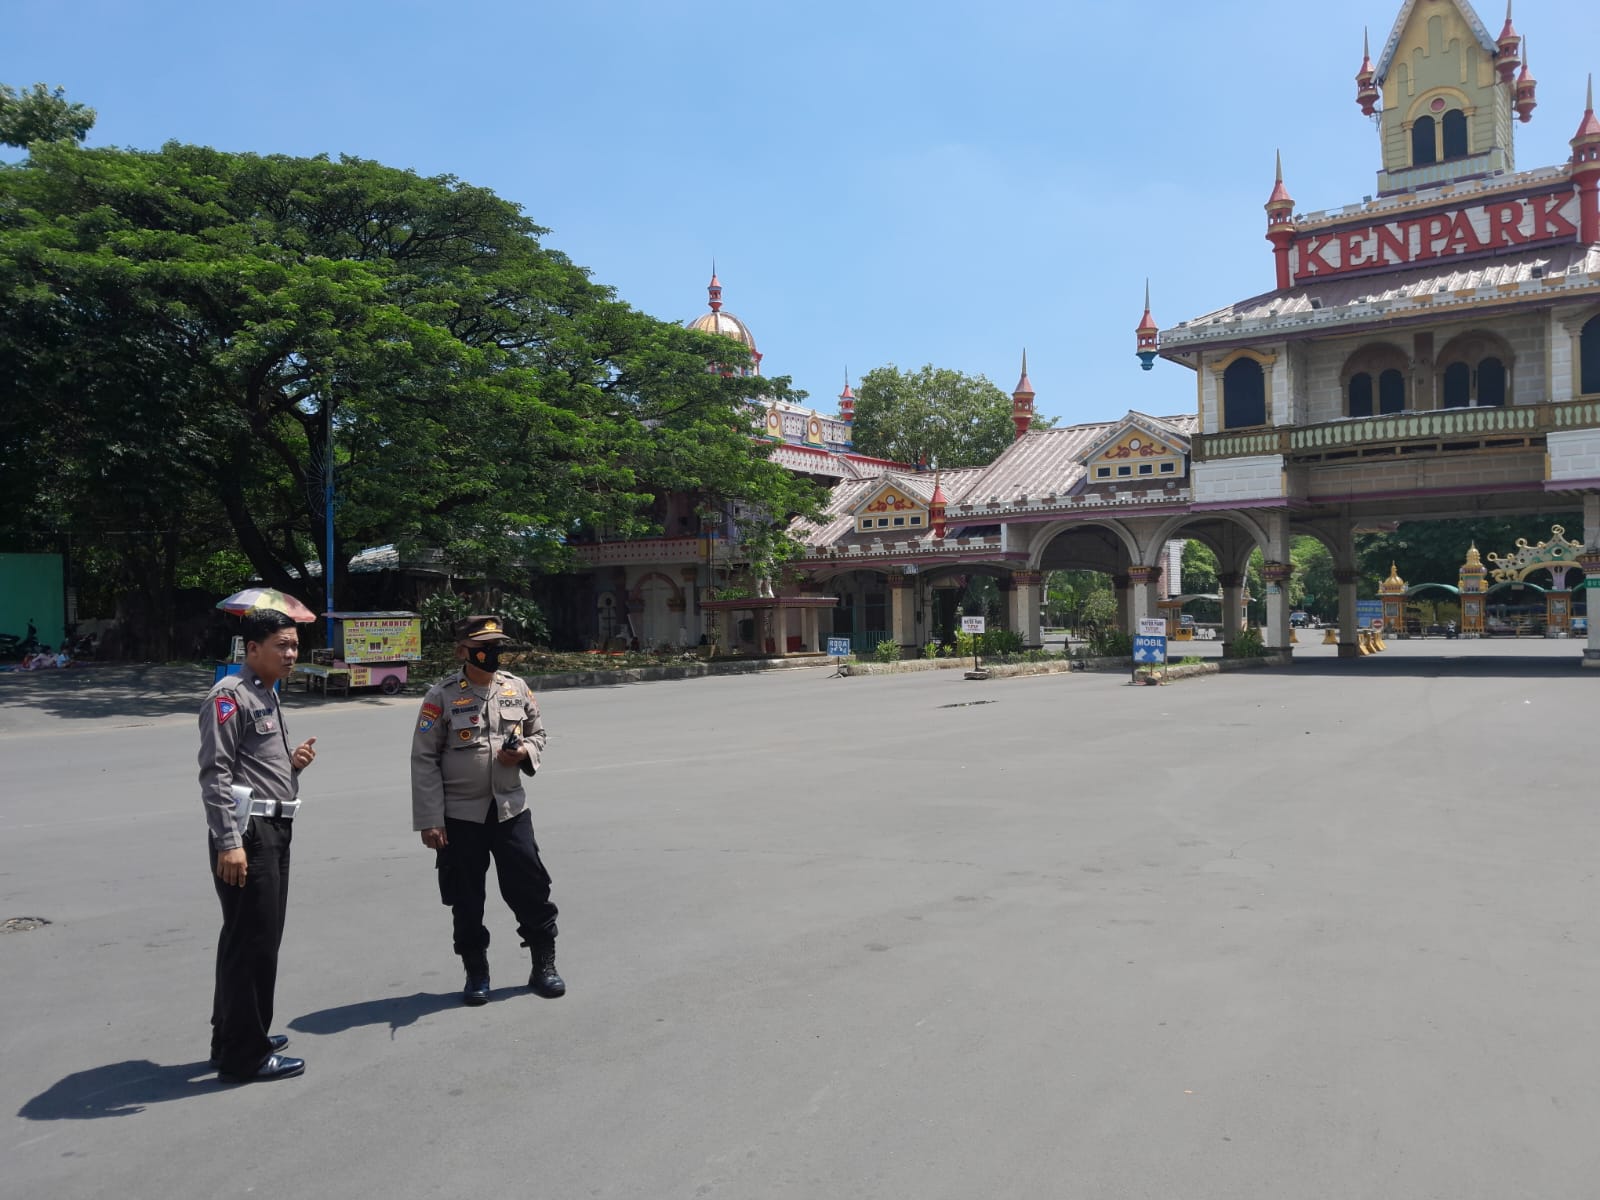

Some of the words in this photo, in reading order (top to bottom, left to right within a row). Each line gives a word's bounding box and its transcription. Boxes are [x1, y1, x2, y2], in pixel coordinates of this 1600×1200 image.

[1294, 190, 1578, 278] KENPARK
[1136, 638, 1164, 647] MOBIL
[500, 699, 523, 707] POLRI
